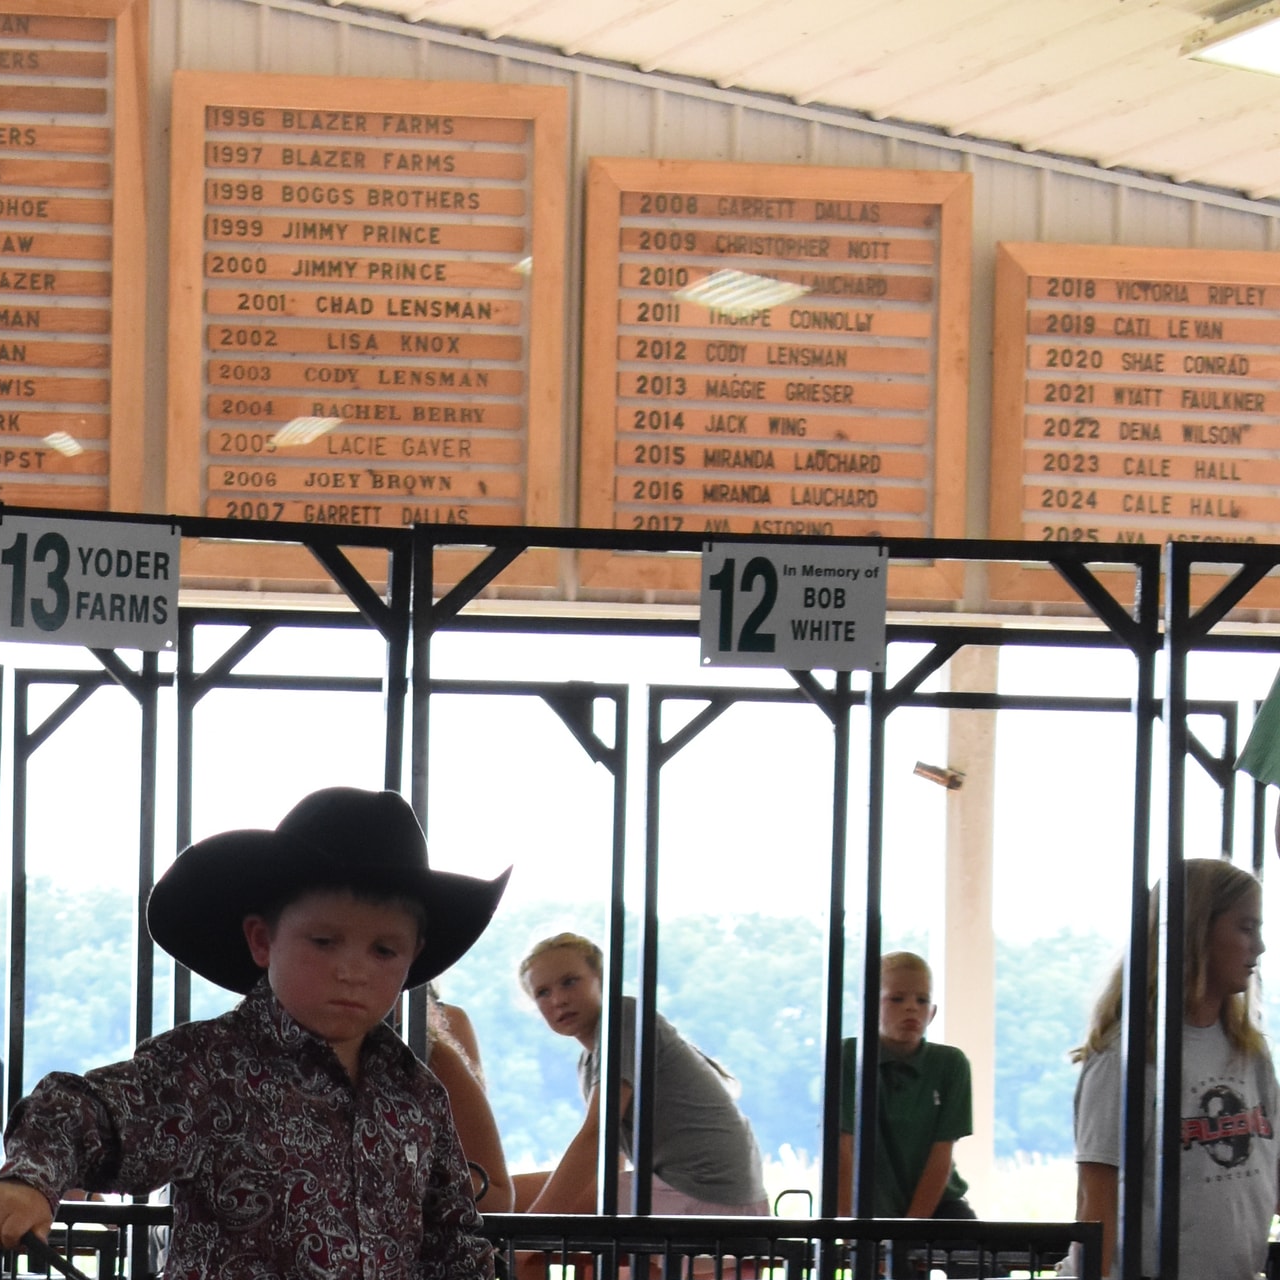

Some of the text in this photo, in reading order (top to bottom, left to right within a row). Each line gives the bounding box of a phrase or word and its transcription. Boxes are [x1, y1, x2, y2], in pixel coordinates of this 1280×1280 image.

[211, 110, 455, 136] 1996 BLAZER FARMS
[211, 147, 455, 173] 1997 BLAZER FARMS
[211, 183, 481, 210] 1998 BOGGS BROTHERS
[211, 219, 441, 245] 1999 JIMMY PRINCE
[211, 257, 447, 282] 2000 JIMMY PRINCE
[1047, 278, 1267, 306] 2018 VICTORIA RIPLEY
[236, 293, 492, 320] 2001 CHAD LENSMAN
[1046, 314, 1095, 334] 2019
[1113, 317, 1151, 338] CATI
[219, 329, 461, 355] 2002 LISA KNOX
[1045, 348, 1250, 376] 2020 SHAE CONRAD
[219, 365, 489, 388] 2003 CODY LENSMAN
[635, 376, 854, 403] 2013 MAGGIE GRIESER
[1044, 383, 1266, 412] 2021 WYATT FAULKNER
[633, 410, 807, 437] 2014 JACK WING
[1042, 418, 1243, 445] 2022 DENA WILSON
[634, 446, 882, 474] 2015 MIRANDA LAUCHARD
[1042, 453, 1242, 481] 2023 CALE HALL
[222, 471, 453, 492] 2006 JOEY BROWN
[633, 481, 878, 509] 2016 MIRANDA LAUCHARD
[1041, 489, 1241, 519] 2024 CALE HALL
[77, 547, 169, 580] YODER
[783, 564, 880, 581] In Memory of
[1, 532, 70, 632] 13
[76, 591, 168, 625] FARMS
[709, 556, 778, 653] 12
[804, 587, 845, 609] BOB
[791, 619, 855, 642] WHITE
